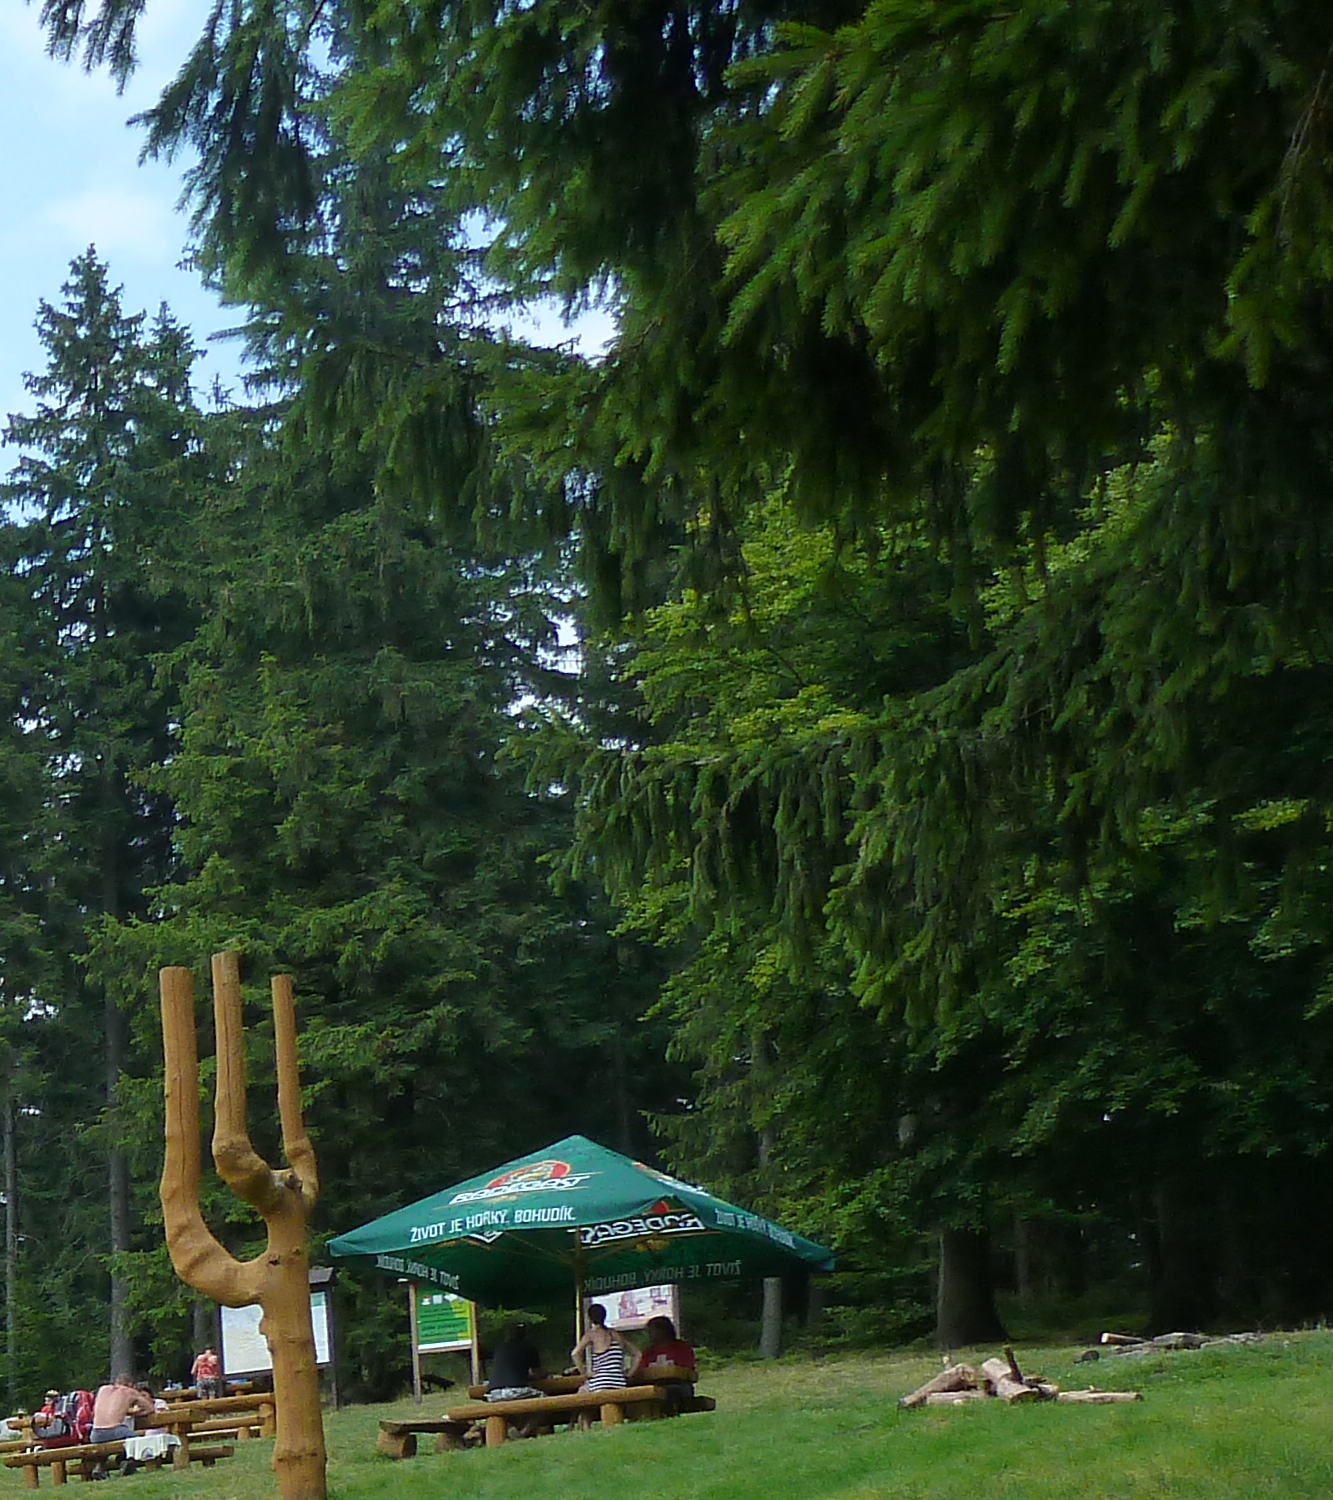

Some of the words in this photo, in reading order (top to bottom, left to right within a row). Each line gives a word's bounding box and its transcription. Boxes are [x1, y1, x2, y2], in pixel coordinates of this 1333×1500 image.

[410, 1221, 445, 1242] ŽIVOT
[449, 1218, 462, 1233] JE
[514, 1204, 576, 1223] BOHUDÍK.
